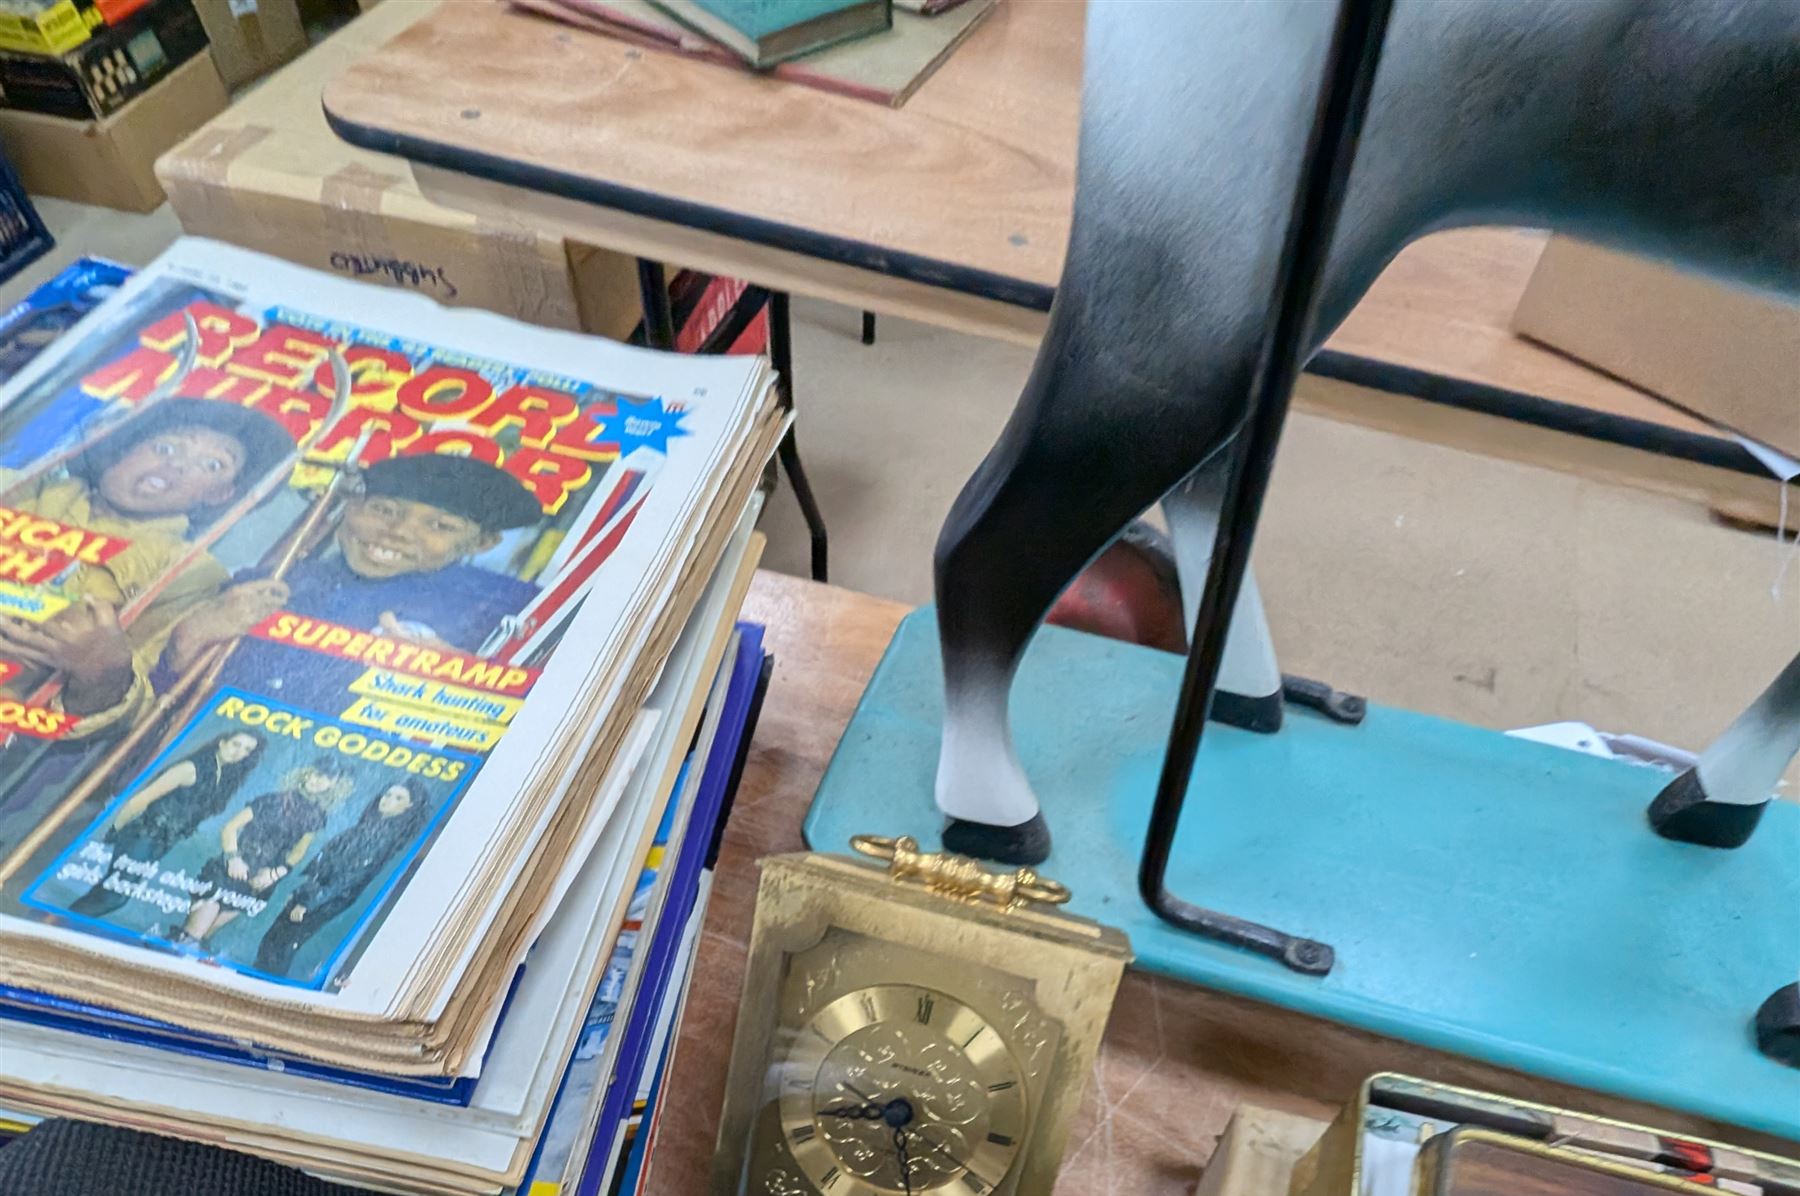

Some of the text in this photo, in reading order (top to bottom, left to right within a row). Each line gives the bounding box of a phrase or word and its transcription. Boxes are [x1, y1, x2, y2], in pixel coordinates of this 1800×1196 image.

[268, 614, 529, 690] SUPERTRAMP
[371, 672, 506, 718] Shark hunting
[216, 696, 467, 781] ROCK GODDESS
[359, 702, 487, 743] for amateurs
[159, 868, 214, 896] about
[209, 887, 268, 917] young
